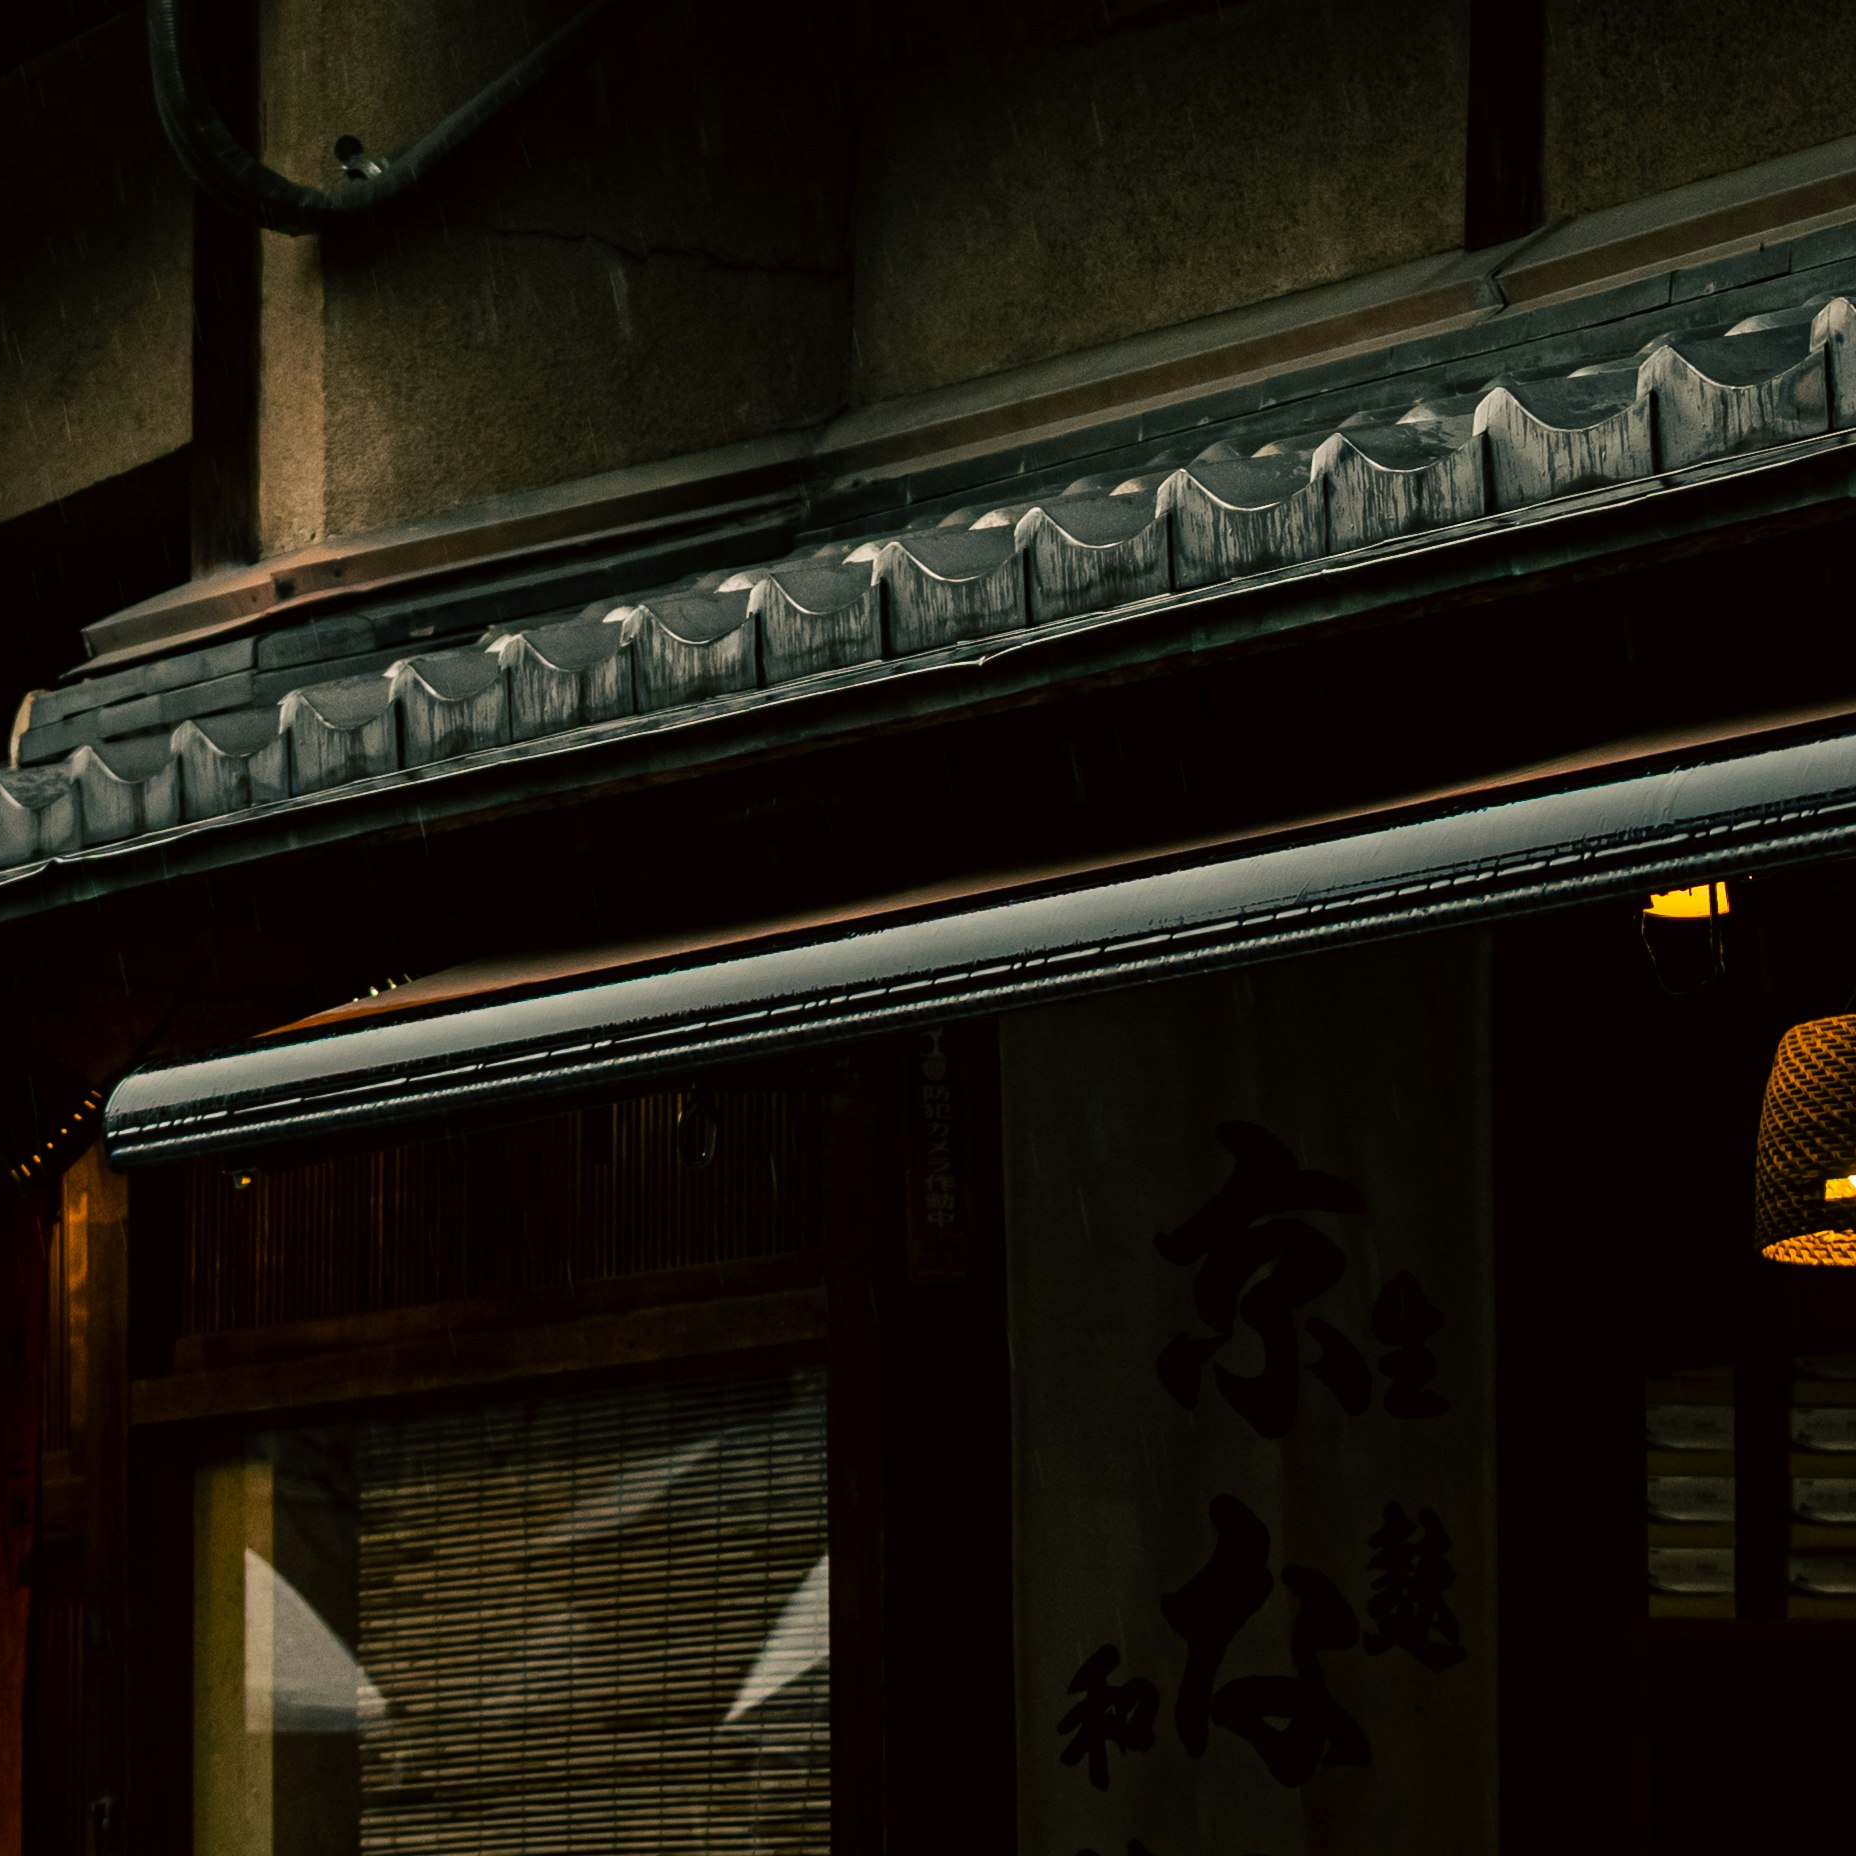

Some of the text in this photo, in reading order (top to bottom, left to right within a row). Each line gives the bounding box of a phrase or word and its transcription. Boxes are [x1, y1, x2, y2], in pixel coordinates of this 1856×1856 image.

[921, 1084, 956, 1229] 防犯カメラ作動中
